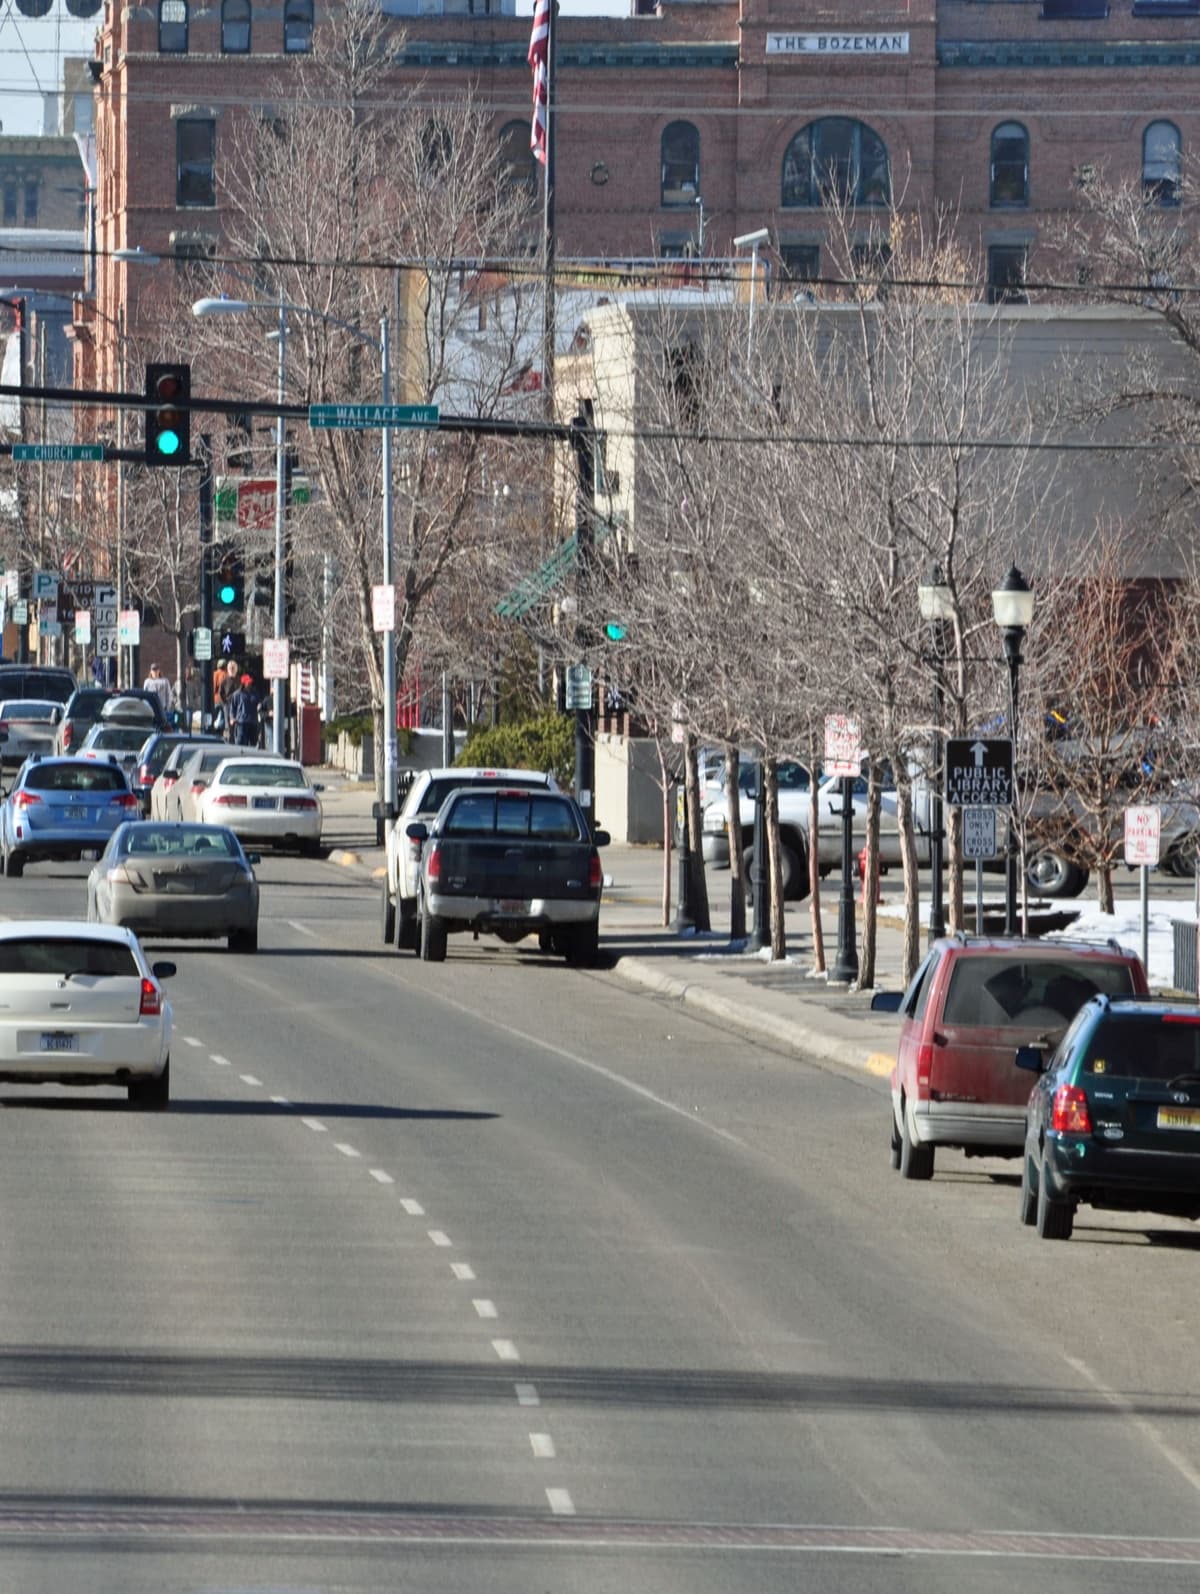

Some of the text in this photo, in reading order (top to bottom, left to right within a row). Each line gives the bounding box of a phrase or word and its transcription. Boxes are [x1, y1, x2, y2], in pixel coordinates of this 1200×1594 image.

[774, 36, 903, 50] THE BOZEMAN
[317, 407, 431, 426] N WALLACE AVE
[33, 446, 74, 460] CHURCH
[80, 449, 94, 460] AVE
[37, 574, 52, 593] P
[953, 767, 1006, 779] PUBLIC
[948, 779, 1010, 791] LIBRARY
[951, 791, 1008, 804] ACCESS
[966, 811, 993, 820] CROSS
[1136, 814, 1150, 825] NO
[968, 821, 990, 830] ONLY
[966, 839, 993, 847] CROSS
